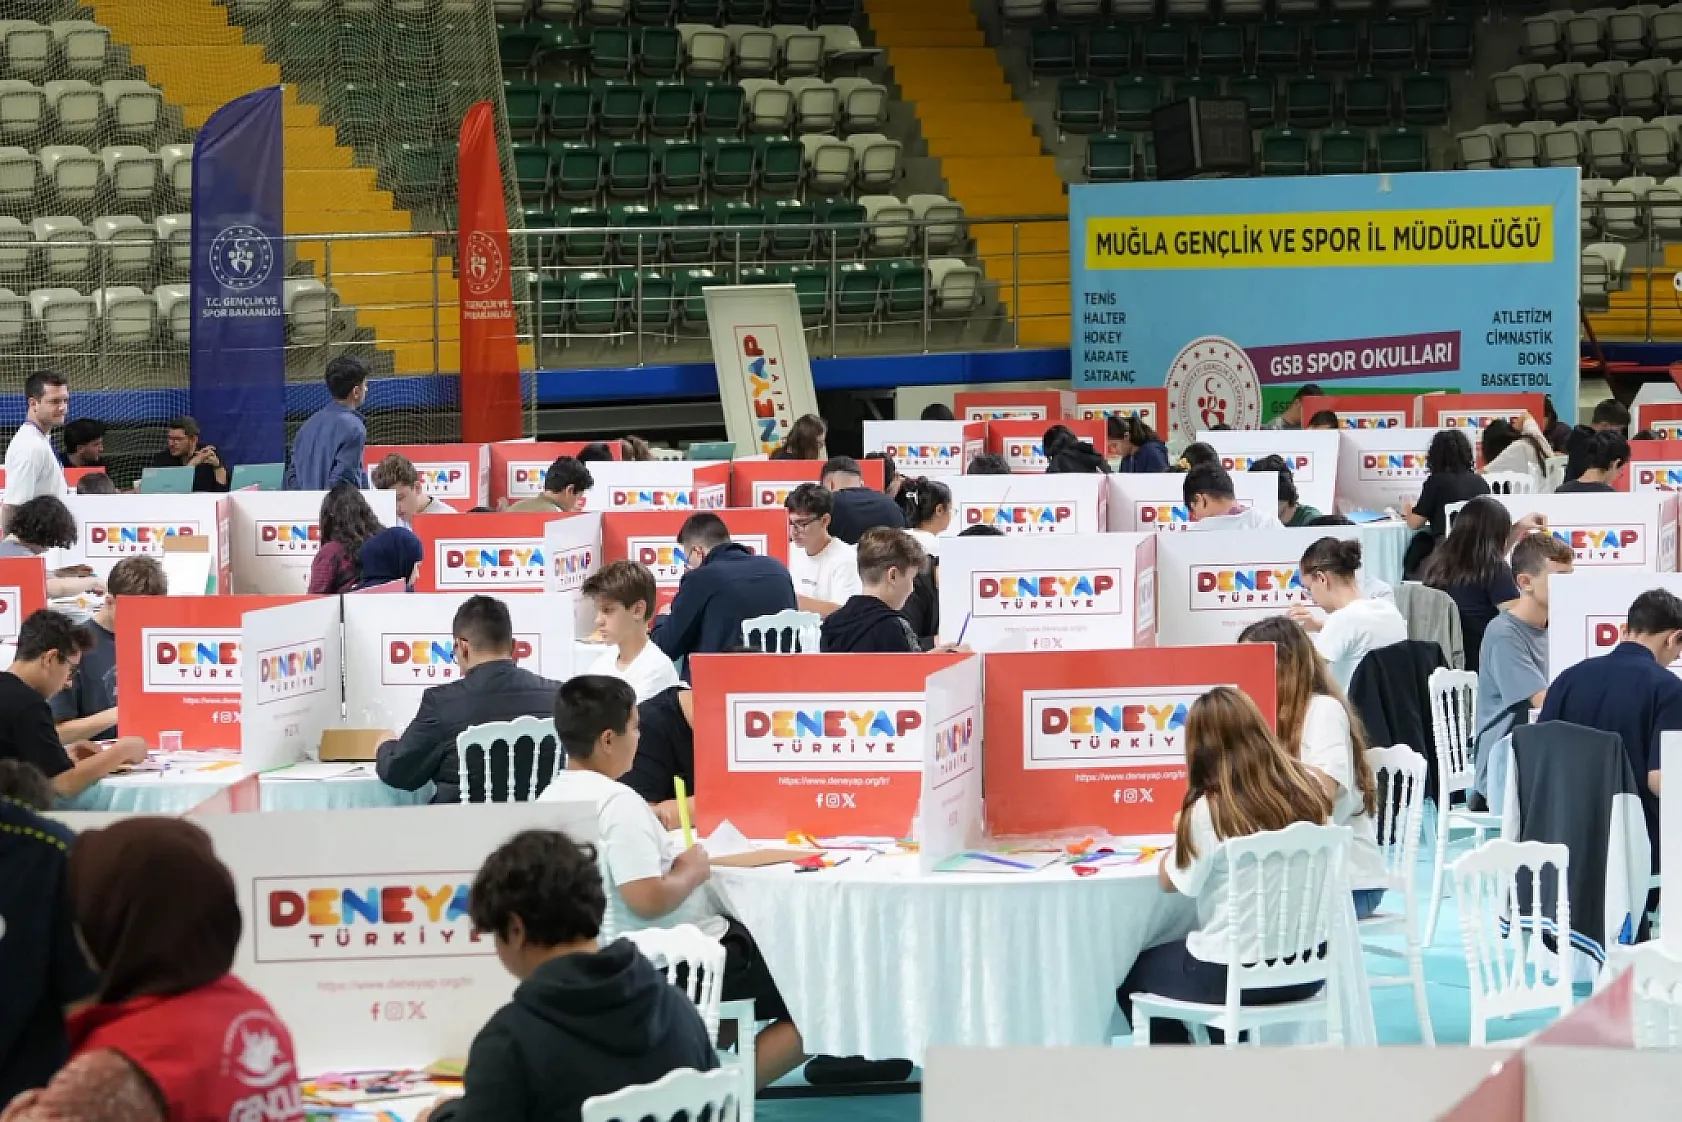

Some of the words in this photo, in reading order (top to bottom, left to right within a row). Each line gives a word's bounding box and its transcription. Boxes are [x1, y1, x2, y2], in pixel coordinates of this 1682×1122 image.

[1097, 226, 1168, 256] MUĞLA
[1174, 224, 1263, 258] GENÇLİK
[1269, 228, 1296, 253] VE
[1301, 227, 1361, 253] SPOR
[1367, 221, 1387, 252] İL
[1393, 217, 1541, 251] MÜDÜRLÜĞÜ
[206, 297, 221, 307] T.C.
[223, 296, 264, 309] GENÇLİK
[1084, 290, 1117, 305] TENİS
[203, 308, 226, 318] SPOR
[229, 307, 281, 317] BAKANLIĞI
[1084, 311, 1127, 325] HALTER
[1492, 307, 1552, 324] ATLETİZM
[1084, 331, 1122, 344] HOKEY
[1486, 329, 1553, 345] CİMNASTİK
[1084, 350, 1129, 363] KARATE
[1270, 354, 1303, 377] GSB
[1307, 350, 1356, 374] SPOR
[1360, 342, 1453, 370] OKULLARI
[1518, 352, 1552, 365] BOKS
[1084, 369, 1136, 384] SATRANÇ
[1481, 373, 1552, 387] BASKETBOL
[887, 445, 960, 458] DENEYAP
[1364, 454, 1428, 468] DENEY
[614, 491, 693, 505] DENEYA
[966, 507, 1071, 524] DENEYAP
[262, 525, 319, 541] DENE
[1006, 524, 1056, 533] RKİYE
[277, 541, 318, 550] TÜRK
[1552, 529, 1639, 548] NEYAP
[107, 544, 156, 552] TÜRKİ
[1576, 549, 1620, 559] KİYE
[446, 548, 544, 568] DENEYA
[979, 576, 1114, 598] DENEYAP
[1198, 569, 1304, 592] DENEYA
[1001, 597, 1093, 609] TÜRKİYE
[157, 642, 237, 665] DENE
[178, 665, 233, 678] TÜRK
[260, 647, 322, 683] DENEYAP
[745, 709, 922, 738] DENEYAP
[1041, 702, 1188, 735] DENEYA
[773, 740, 896, 753] TÜRKİYE
[1070, 734, 1175, 750] TÜRKİY
[1075, 770, 1187, 783] https://www.deneyap.org/tr
[268, 884, 472, 927] DENEYA
